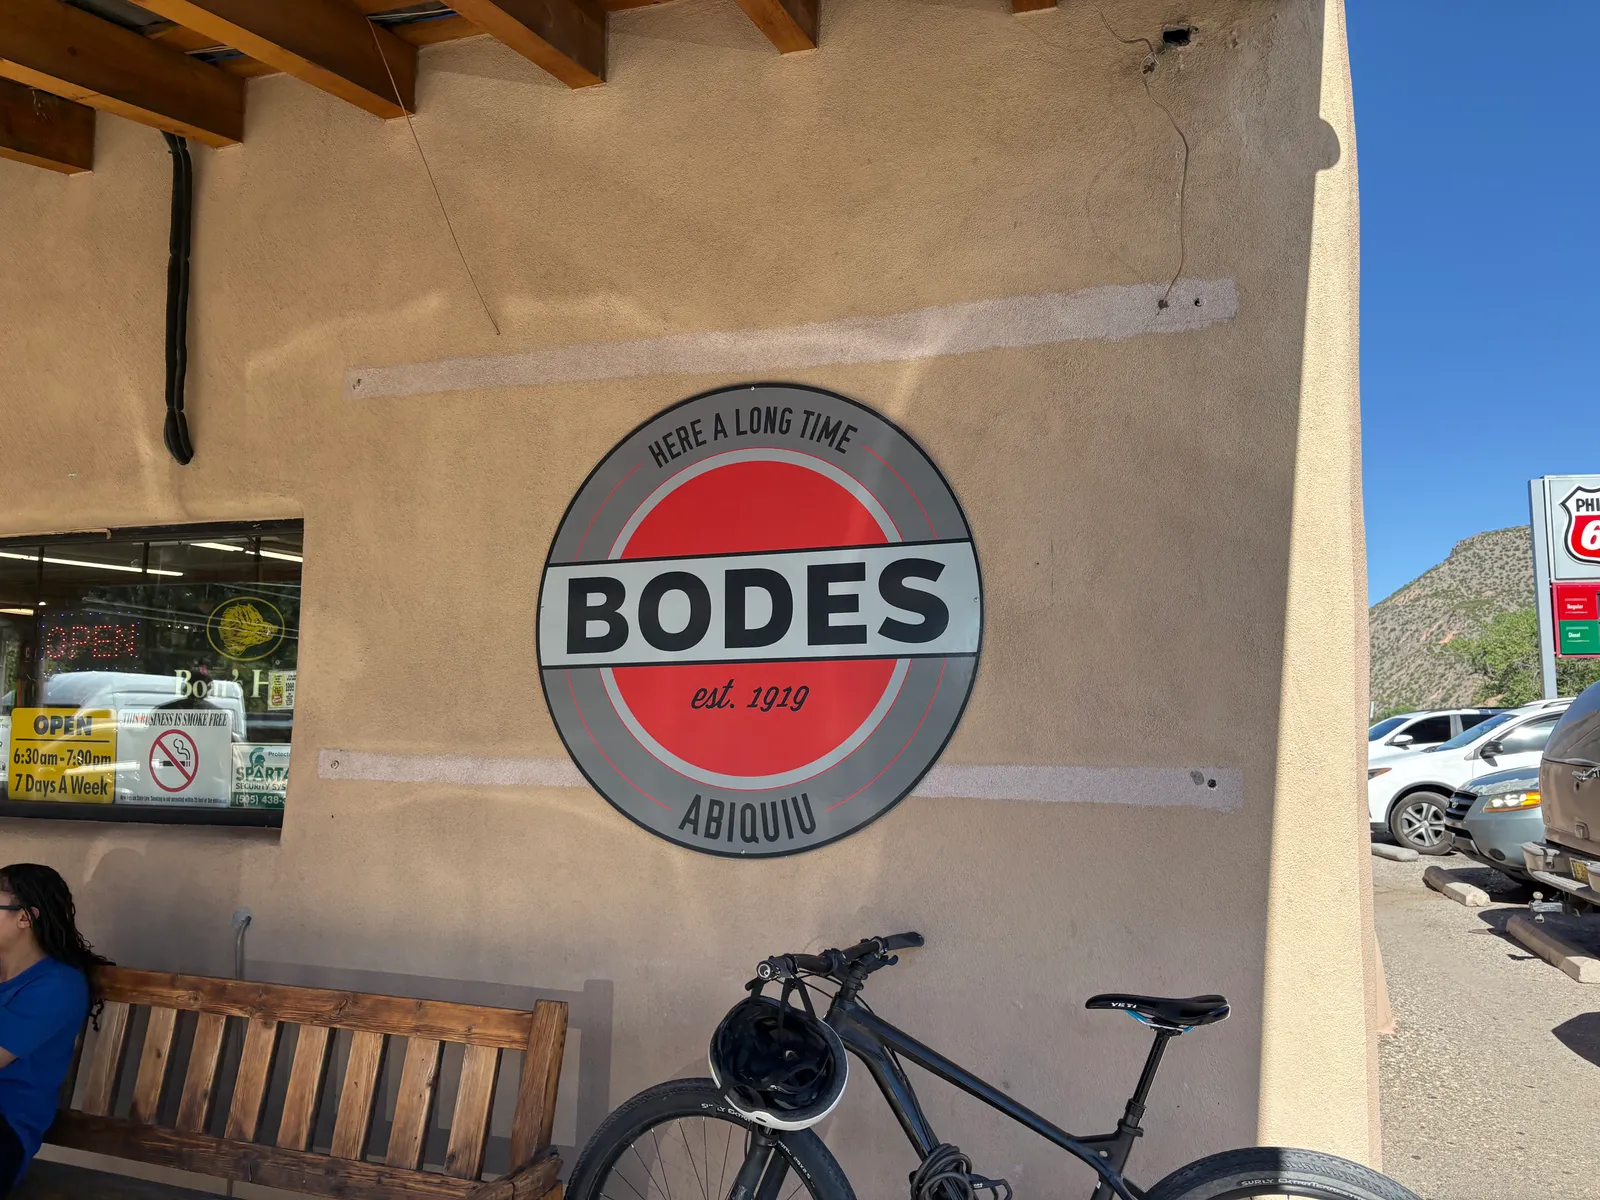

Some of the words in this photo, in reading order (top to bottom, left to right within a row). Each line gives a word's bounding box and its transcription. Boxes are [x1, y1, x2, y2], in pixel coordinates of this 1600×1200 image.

[648, 419, 707, 468] HERE
[713, 412, 728, 441] A
[735, 406, 793, 436] LONG
[800, 409, 858, 454] TIME
[566, 558, 950, 654] BODES
[46, 624, 135, 659] OPEN
[690, 678, 736, 709] est.
[747, 685, 810, 712] 1919
[33, 715, 93, 736] OPEN
[174, 712, 182, 726] IS
[182, 712, 208, 726] SMOKE
[209, 712, 228, 726] FREE
[15, 774, 23, 792] 7
[25, 774, 56, 798] Days
[58, 775, 67, 794] A
[70, 775, 108, 795] Week
[678, 792, 817, 843] ABIQUIU
[1240, 1178, 1275, 1187] SURLY
